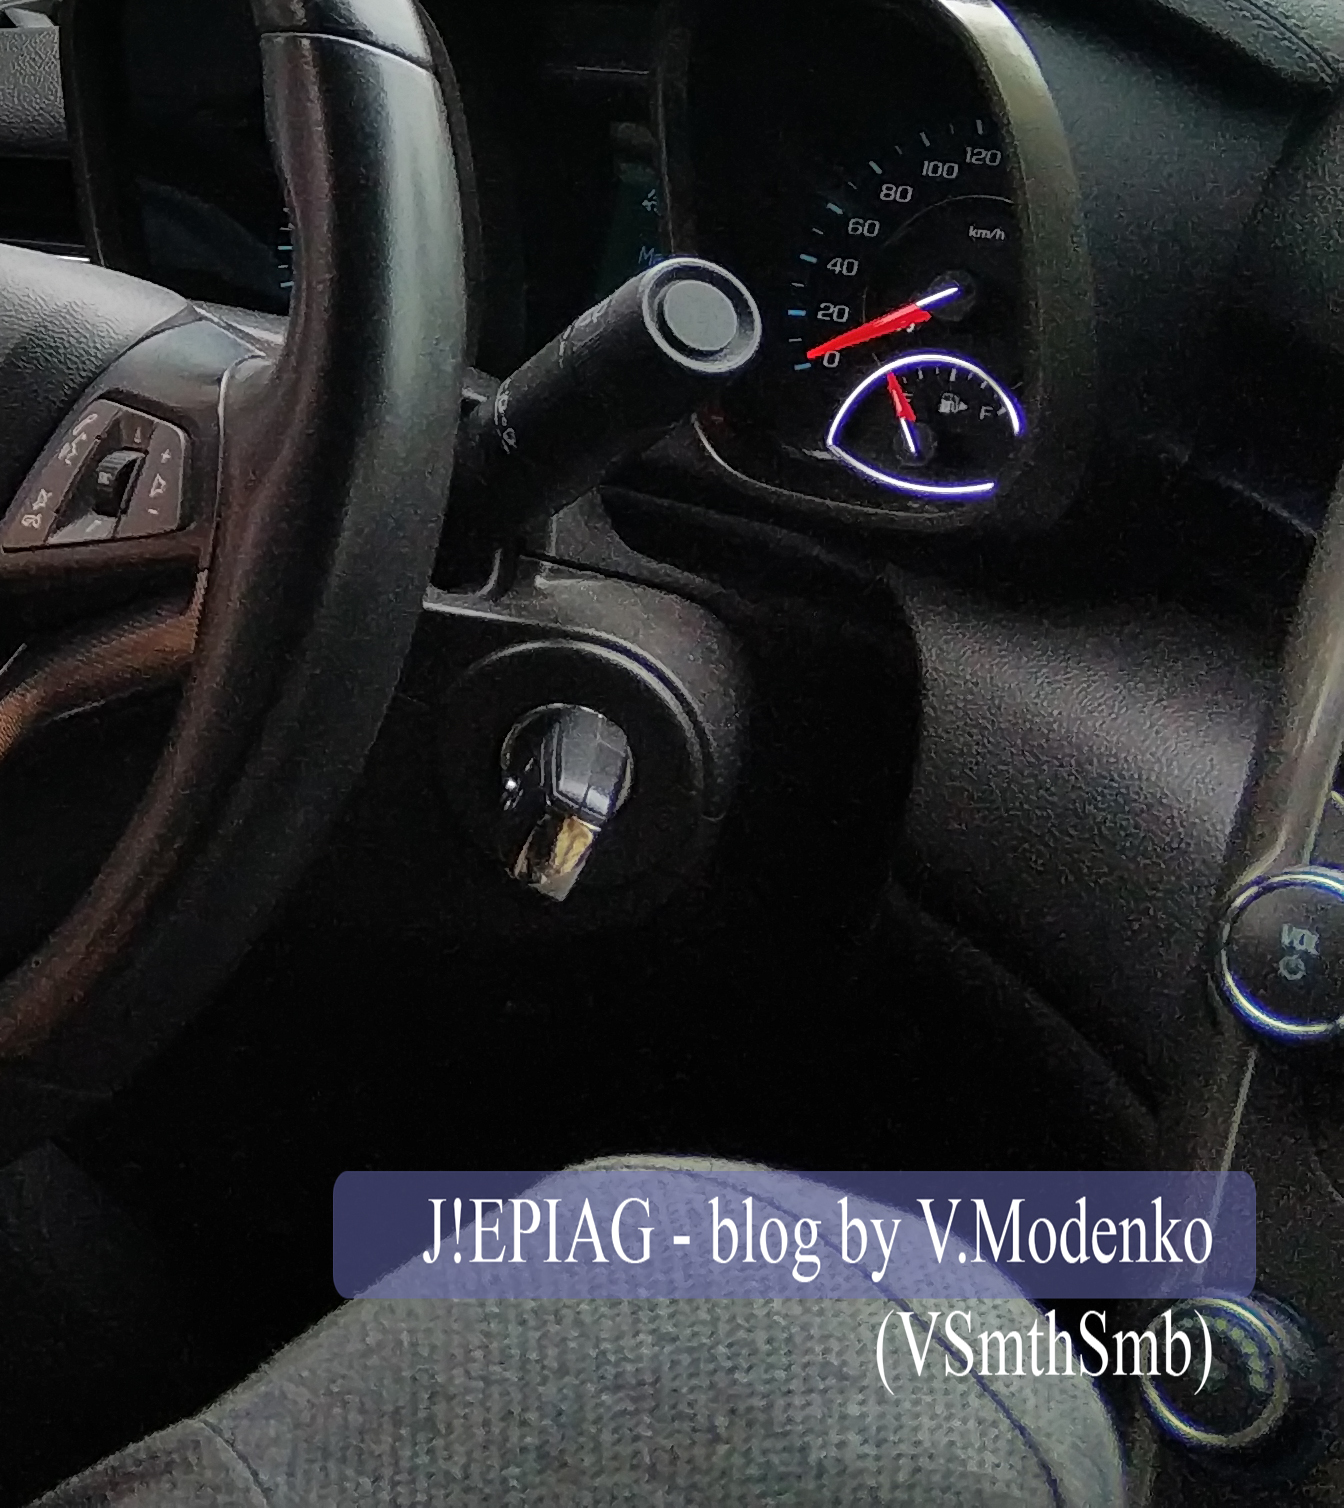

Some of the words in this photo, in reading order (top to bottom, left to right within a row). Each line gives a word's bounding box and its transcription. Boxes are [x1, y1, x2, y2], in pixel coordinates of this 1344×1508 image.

[965, 146, 1002, 167] 120
[922, 160, 959, 179] 100
[879, 184, 913, 203] 80
[848, 217, 880, 237] 60
[968, 224, 1006, 241] km/h
[826, 257, 859, 276] 40
[817, 303, 850, 323] 20
[823, 350, 840, 368] 0
[979, 405, 994, 420] F
